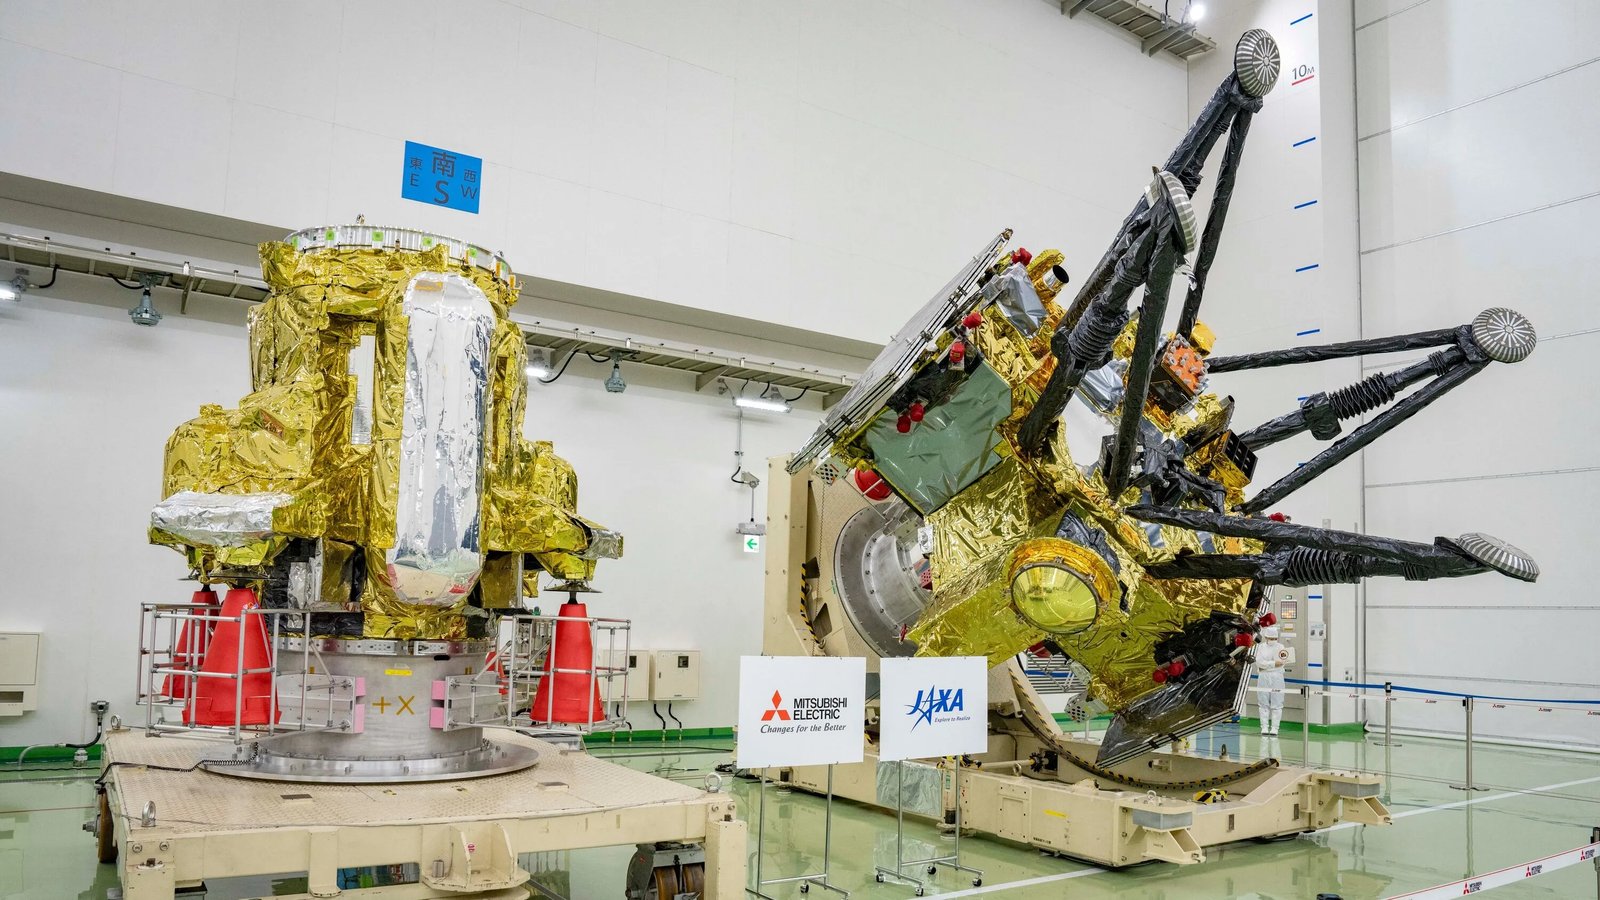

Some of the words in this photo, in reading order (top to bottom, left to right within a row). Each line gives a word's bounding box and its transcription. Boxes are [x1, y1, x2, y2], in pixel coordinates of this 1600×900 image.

[432, 152, 456, 177] 南
[463, 168, 477, 183] 西
[410, 173, 419, 187] E
[433, 180, 450, 204] S
[461, 184, 478, 200] W
[793, 697, 848, 709] MITSUBISHI
[793, 708, 841, 720] ELECTRIC
[904, 685, 964, 732] JAXA
[760, 724, 794, 735] Changes
[795, 724, 809, 733] for
[810, 723, 822, 732] the
[823, 722, 847, 732] Better
